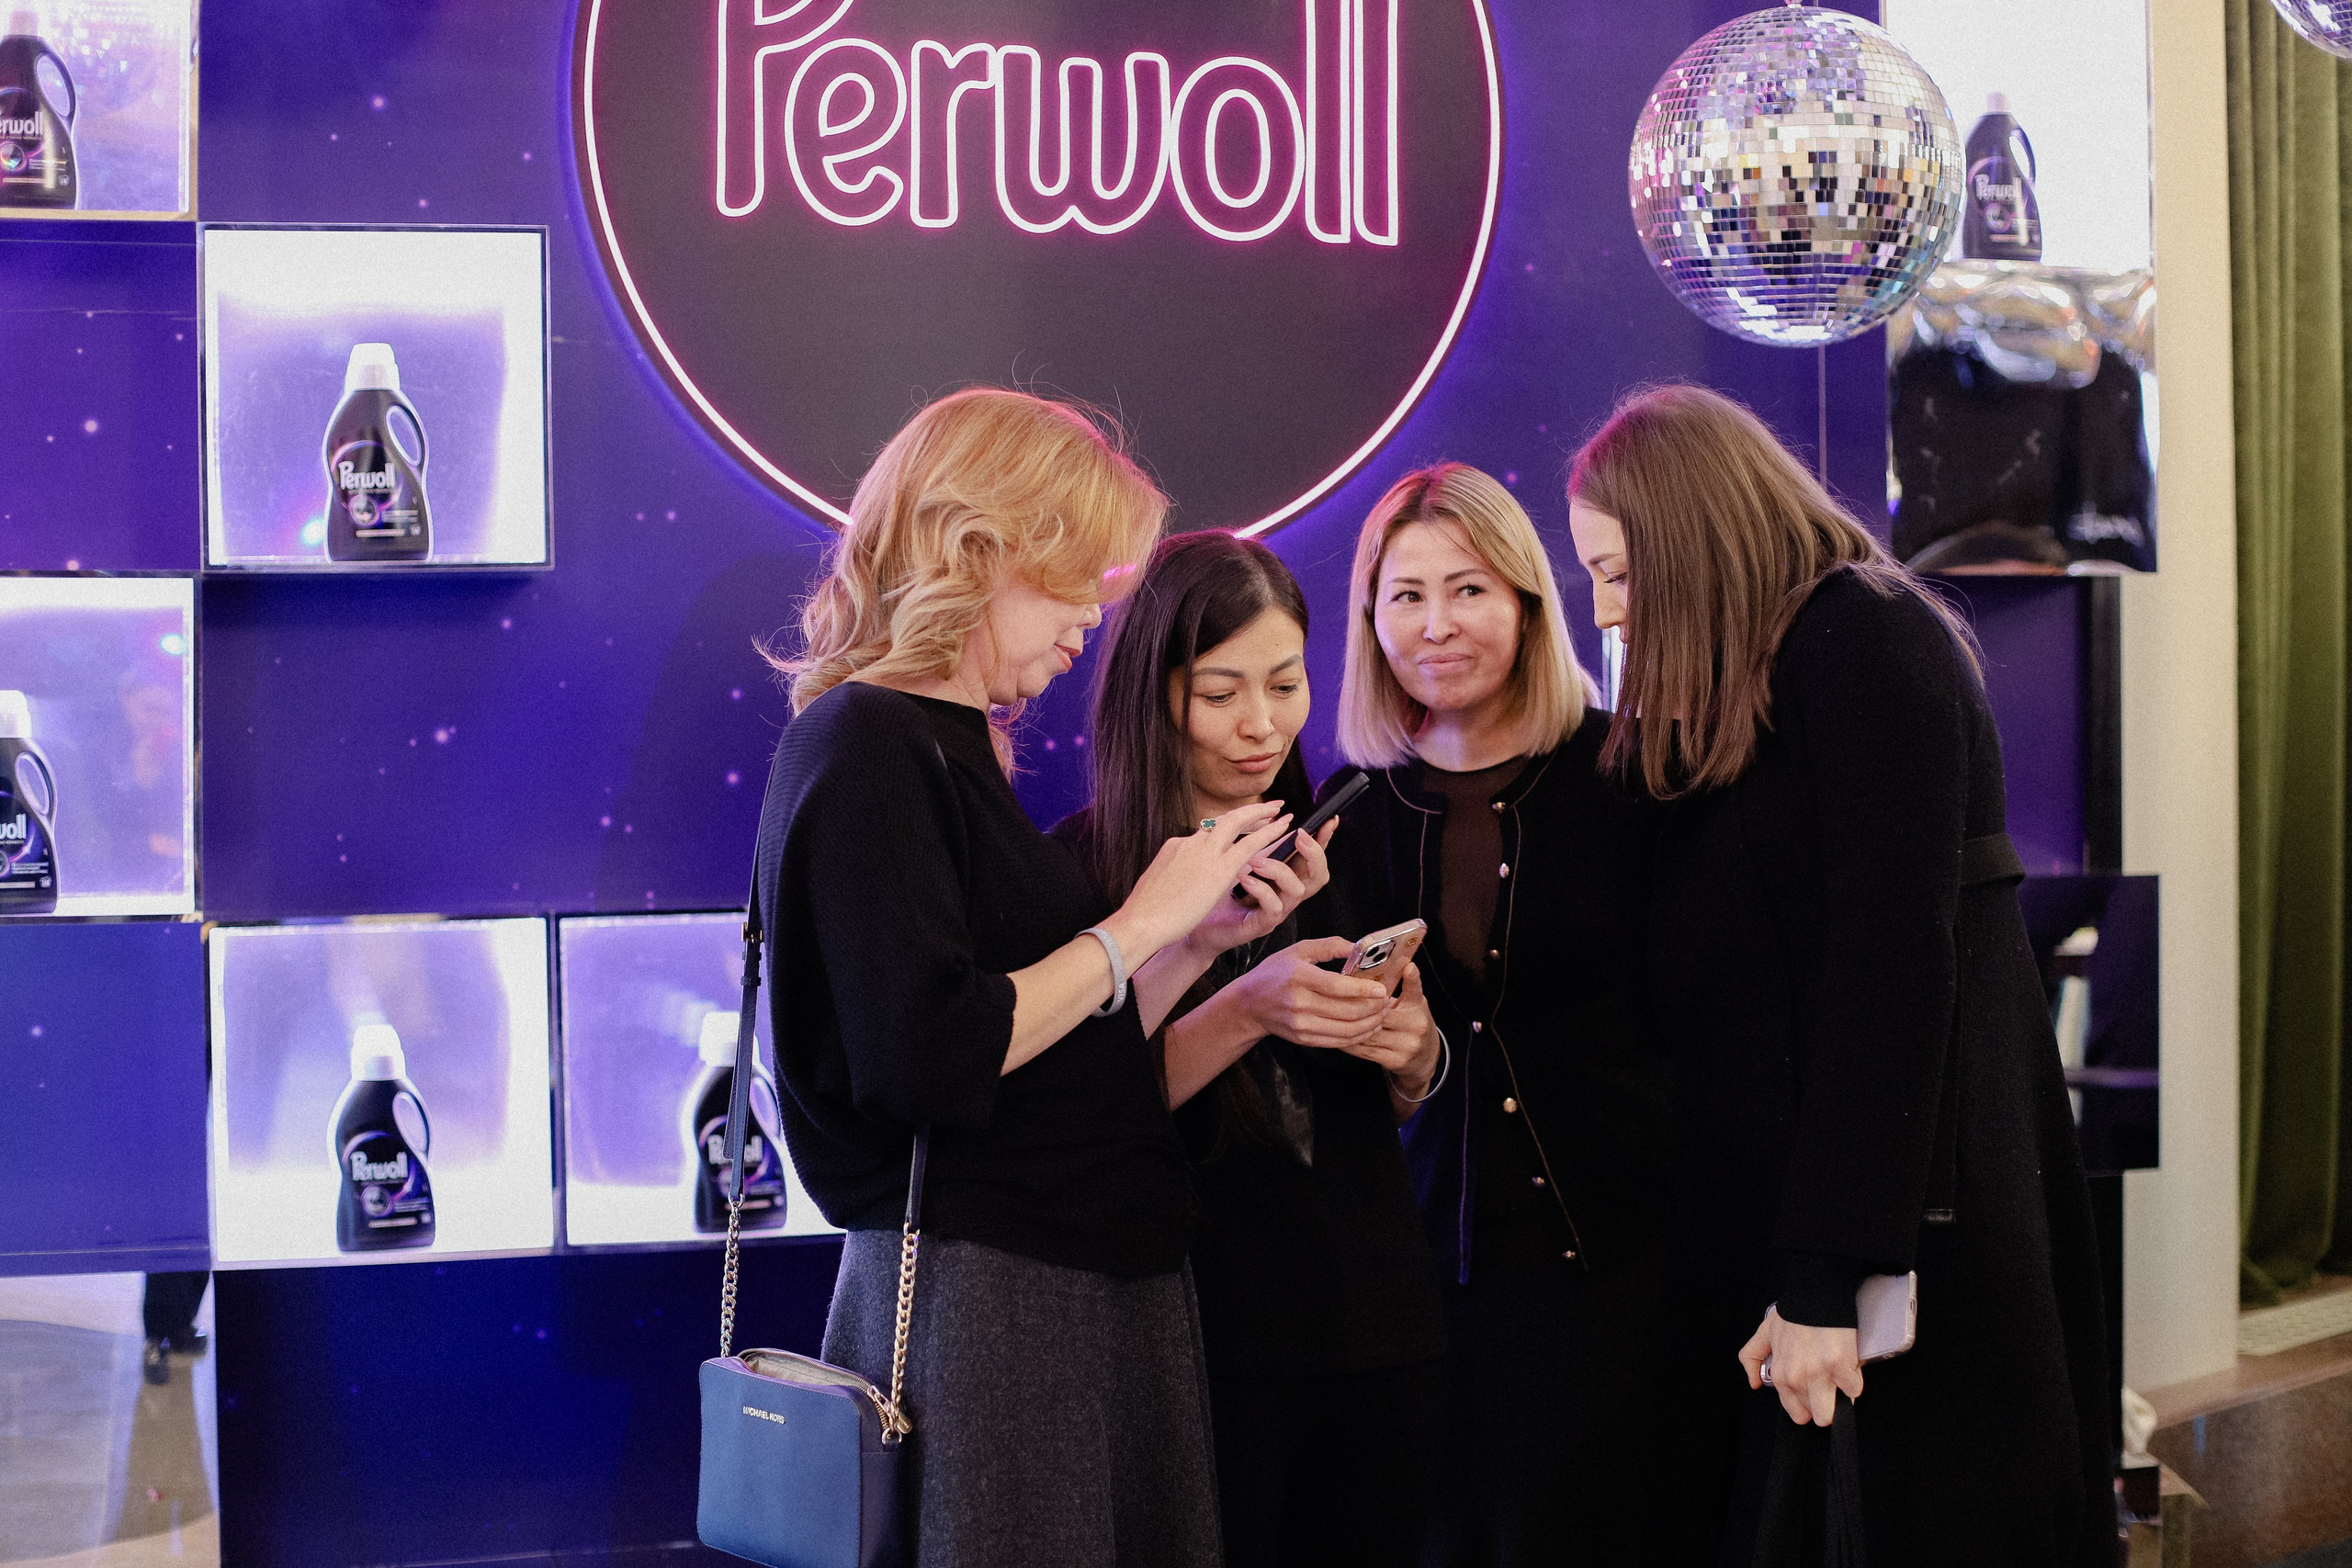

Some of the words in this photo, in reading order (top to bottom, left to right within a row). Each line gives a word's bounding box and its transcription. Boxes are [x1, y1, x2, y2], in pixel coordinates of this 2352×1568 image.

[716, 0, 1398, 246] Perwoll
[338, 460, 396, 490] Perwoll
[1117, 982, 1126, 1003] VISA
[742, 1405, 770, 1420] MICHAEL
[770, 1412, 785, 1424] KORS
